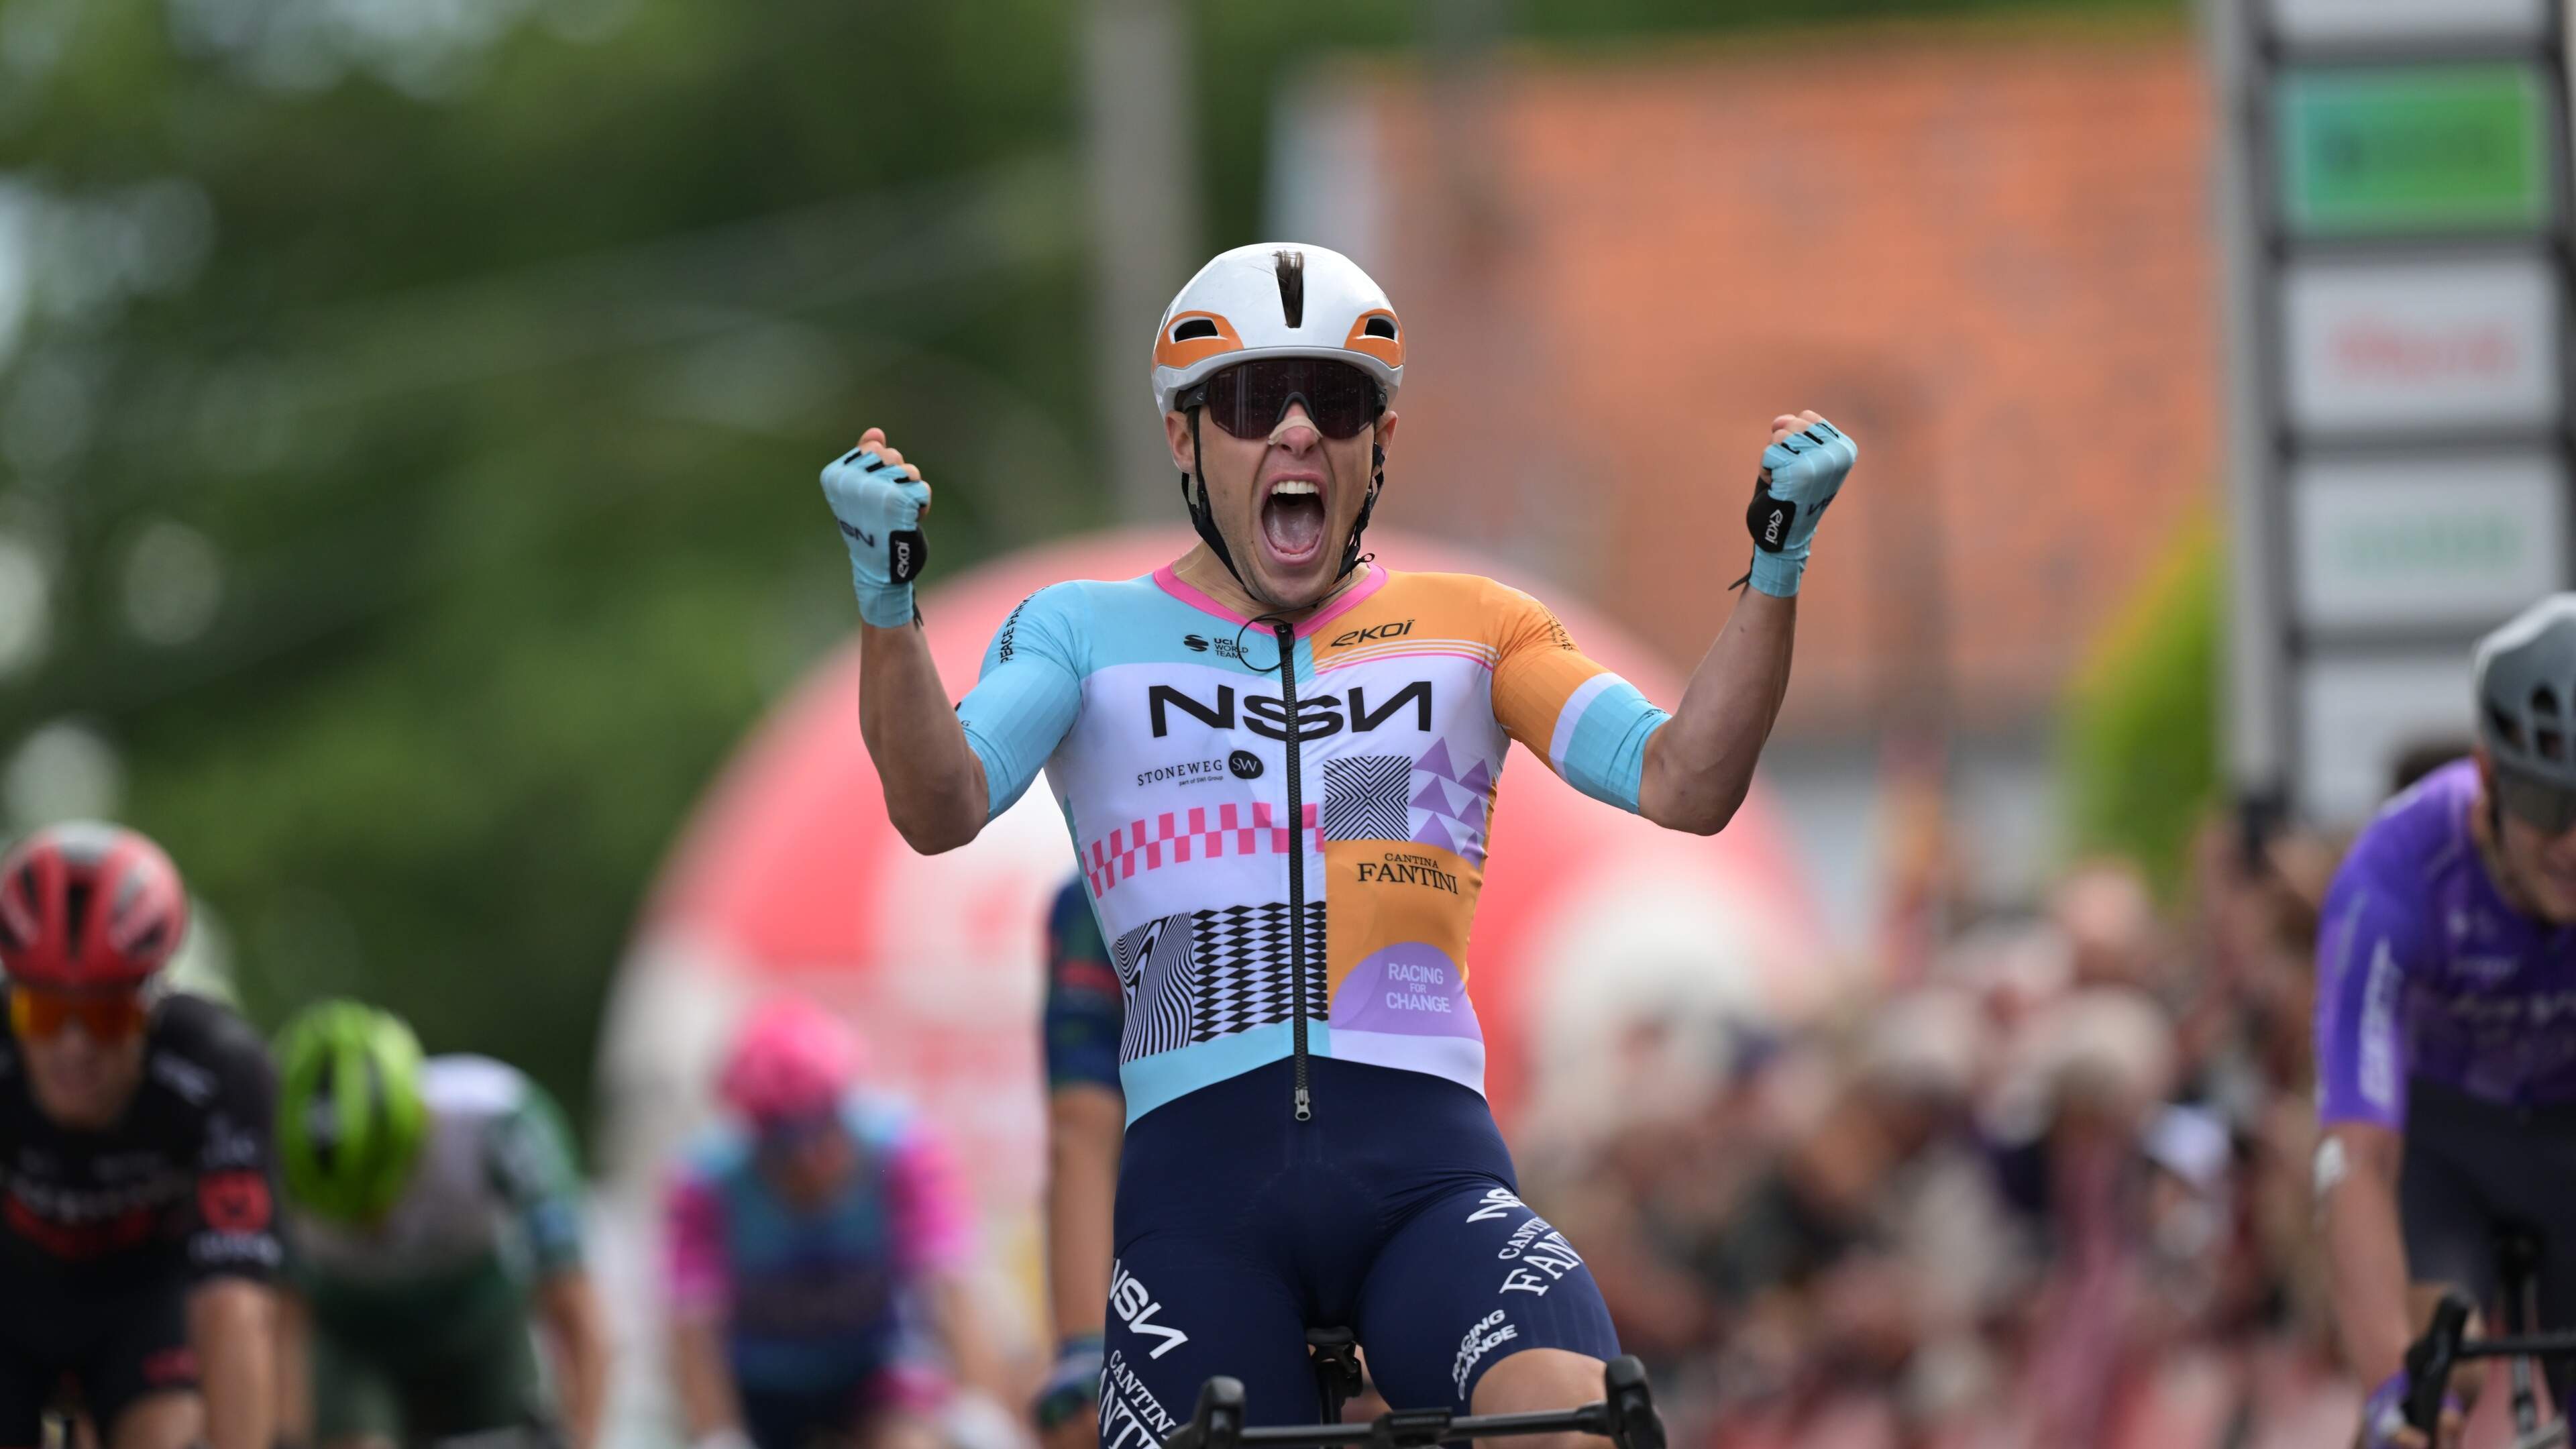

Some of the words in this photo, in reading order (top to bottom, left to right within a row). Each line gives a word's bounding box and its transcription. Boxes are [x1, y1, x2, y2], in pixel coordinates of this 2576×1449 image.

[1000, 627, 1014, 663] PEACE
[1214, 644, 1249, 653] WORLD
[1215, 649, 1242, 659] TEAM
[1148, 681, 1432, 742] NSN
[1137, 759, 1223, 786] STONEWEG
[1232, 757, 1258, 772] SW
[1385, 853, 1439, 869] CANTINA
[1357, 863, 1458, 895] FANTINI
[1388, 963, 1444, 985] RACING
[1409, 983, 1426, 994] FOR
[1386, 991, 1452, 1013] CHANGE
[1110, 1350, 1177, 1441] CANTIN
